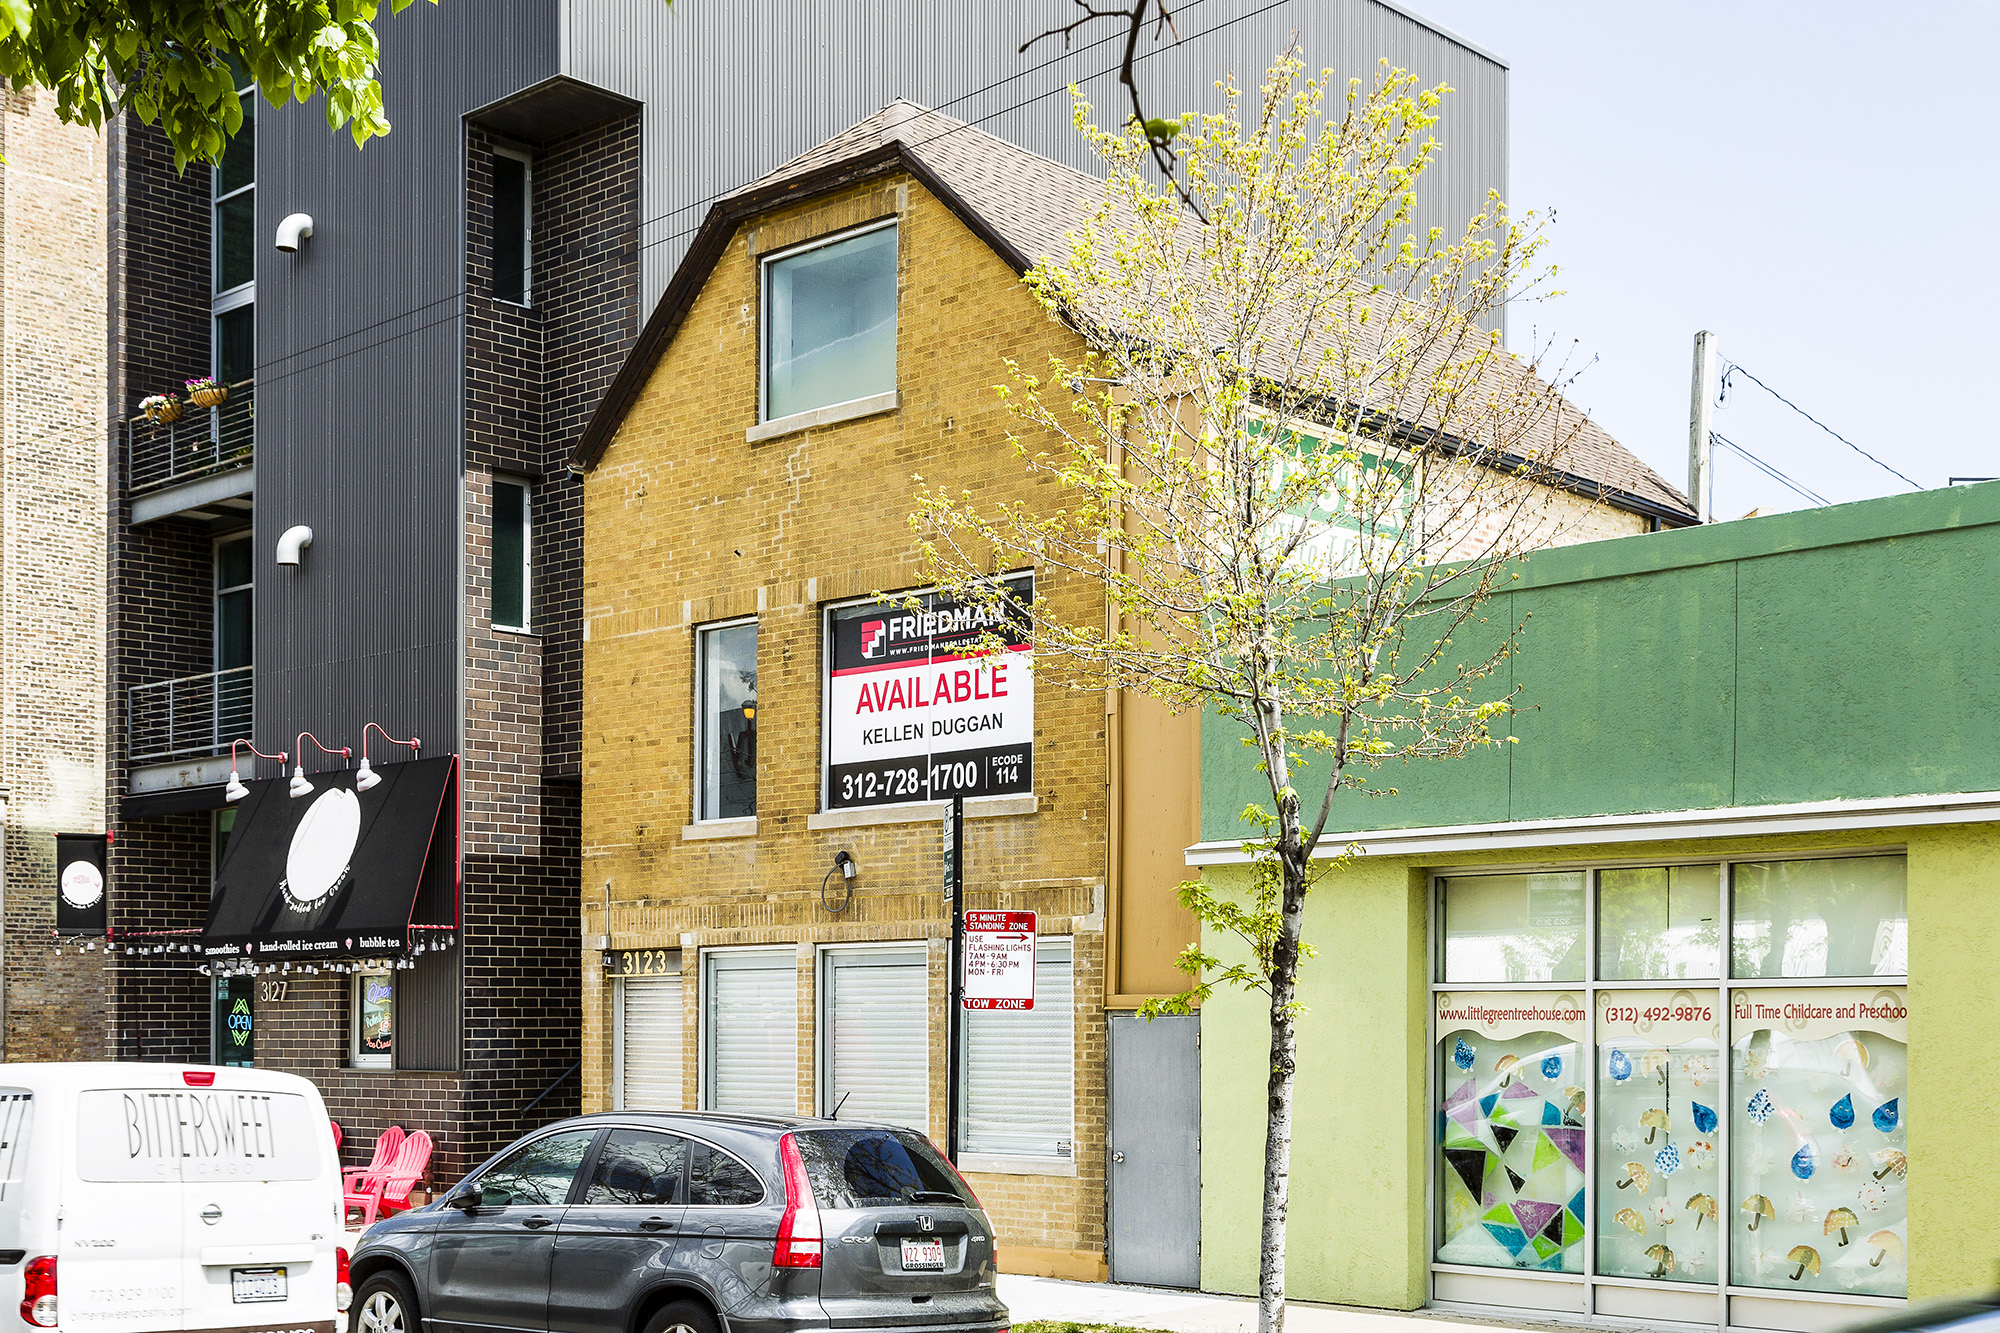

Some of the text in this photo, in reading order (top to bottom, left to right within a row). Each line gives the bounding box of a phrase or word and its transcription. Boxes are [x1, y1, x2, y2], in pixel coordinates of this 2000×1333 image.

[889, 602, 1005, 641] FRIEDMAN
[855, 664, 1008, 715] AVAILABLE
[863, 712, 1004, 745] KELLEN DUGGAN
[992, 753, 1024, 767] ECODE
[842, 760, 978, 800] 312-728-1700
[996, 766, 1019, 785] 114
[969, 913, 978, 922] 15
[979, 913, 1007, 922] MINUTE
[969, 922, 1029, 930] STANDING ZONE
[259, 939, 338, 952] hand-rolled ice cream
[359, 936, 400, 948] bubble tea
[969, 935, 984, 943] USE
[205, 943, 240, 956] smoothies
[969, 944, 1032, 952] FLASHING LIGHTS
[622, 950, 666, 974] 3123
[968, 968, 985, 976] MON
[991, 968, 1004, 976] FRI
[261, 981, 288, 1002] 3127
[966, 998, 1026, 1009] TOW ZONE
[1735, 1004, 1752, 1019] Full
[1755, 1004, 1781, 1019] Time
[1783, 1003, 1832, 1019] Childcare
[1835, 1003, 1856, 1019] and
[228, 1014, 253, 1031] OPEN
[1439, 1005, 1586, 1025] www.littlegreentreehouse.com
[1605, 1007, 1712, 1024] (312) 492-9876
[123, 1093, 275, 1158] BITTERSWEET
[155, 1162, 254, 1175] CHICAGO
[903, 1246, 943, 1263] V22 9309
